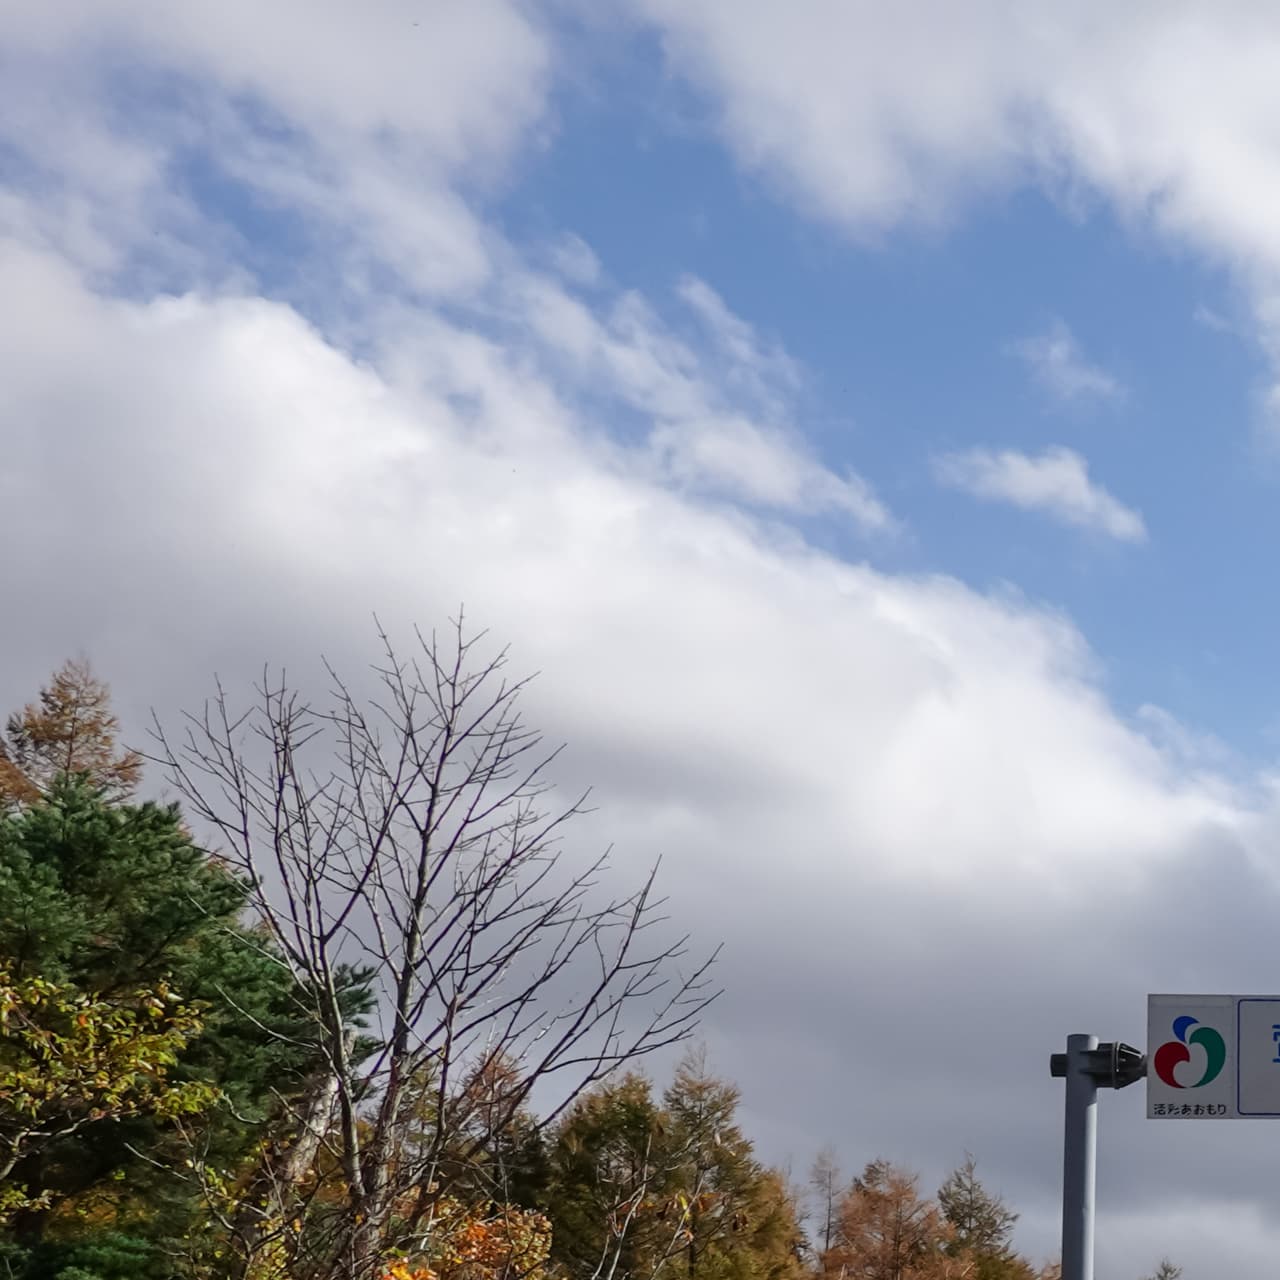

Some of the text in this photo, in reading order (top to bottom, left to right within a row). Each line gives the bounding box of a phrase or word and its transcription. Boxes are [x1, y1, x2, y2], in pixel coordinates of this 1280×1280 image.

[1153, 1103, 1227, 1116] 活彩あおもり
